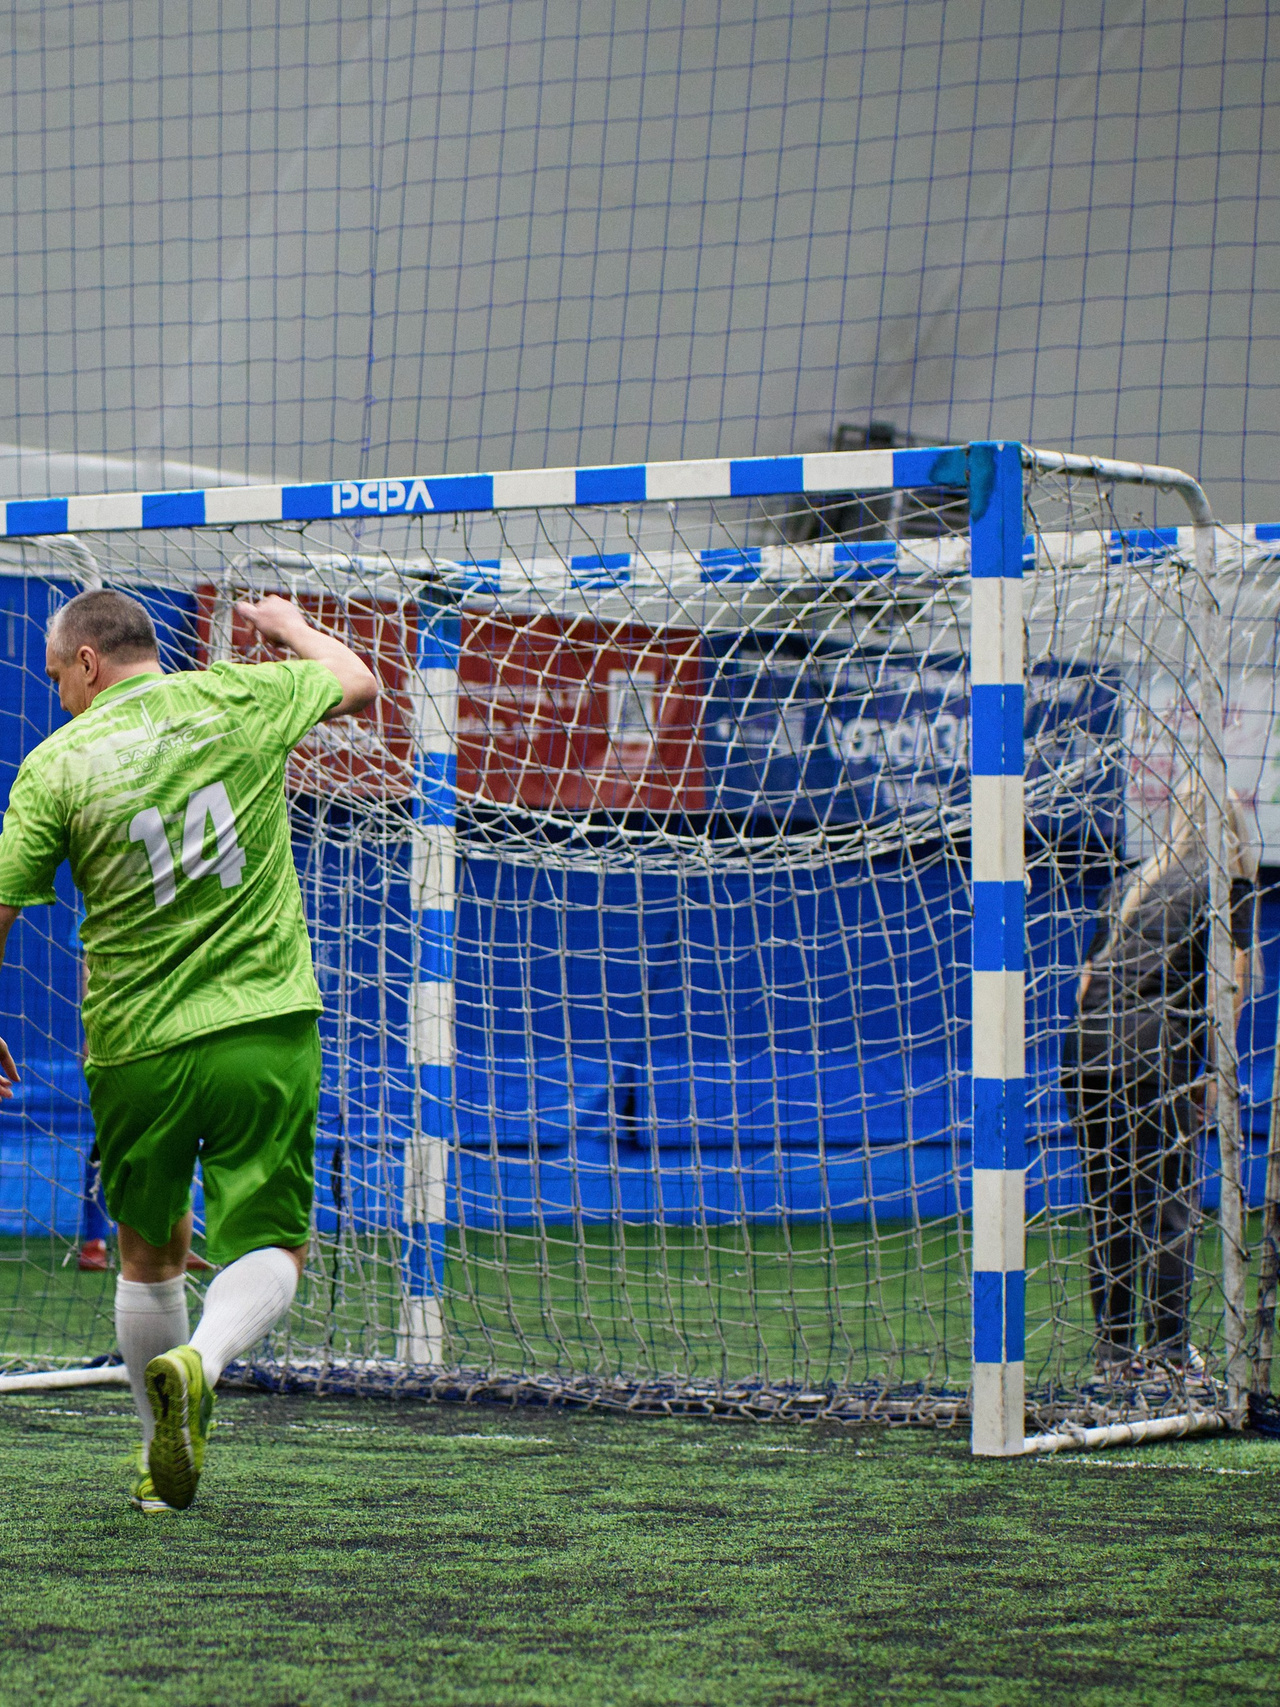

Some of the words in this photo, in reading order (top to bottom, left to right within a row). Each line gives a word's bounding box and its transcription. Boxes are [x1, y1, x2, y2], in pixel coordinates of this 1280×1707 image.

[118, 729, 195, 766] БАЛАНС
[132, 744, 193, 774] TOWERS
[129, 780, 247, 908] 14
